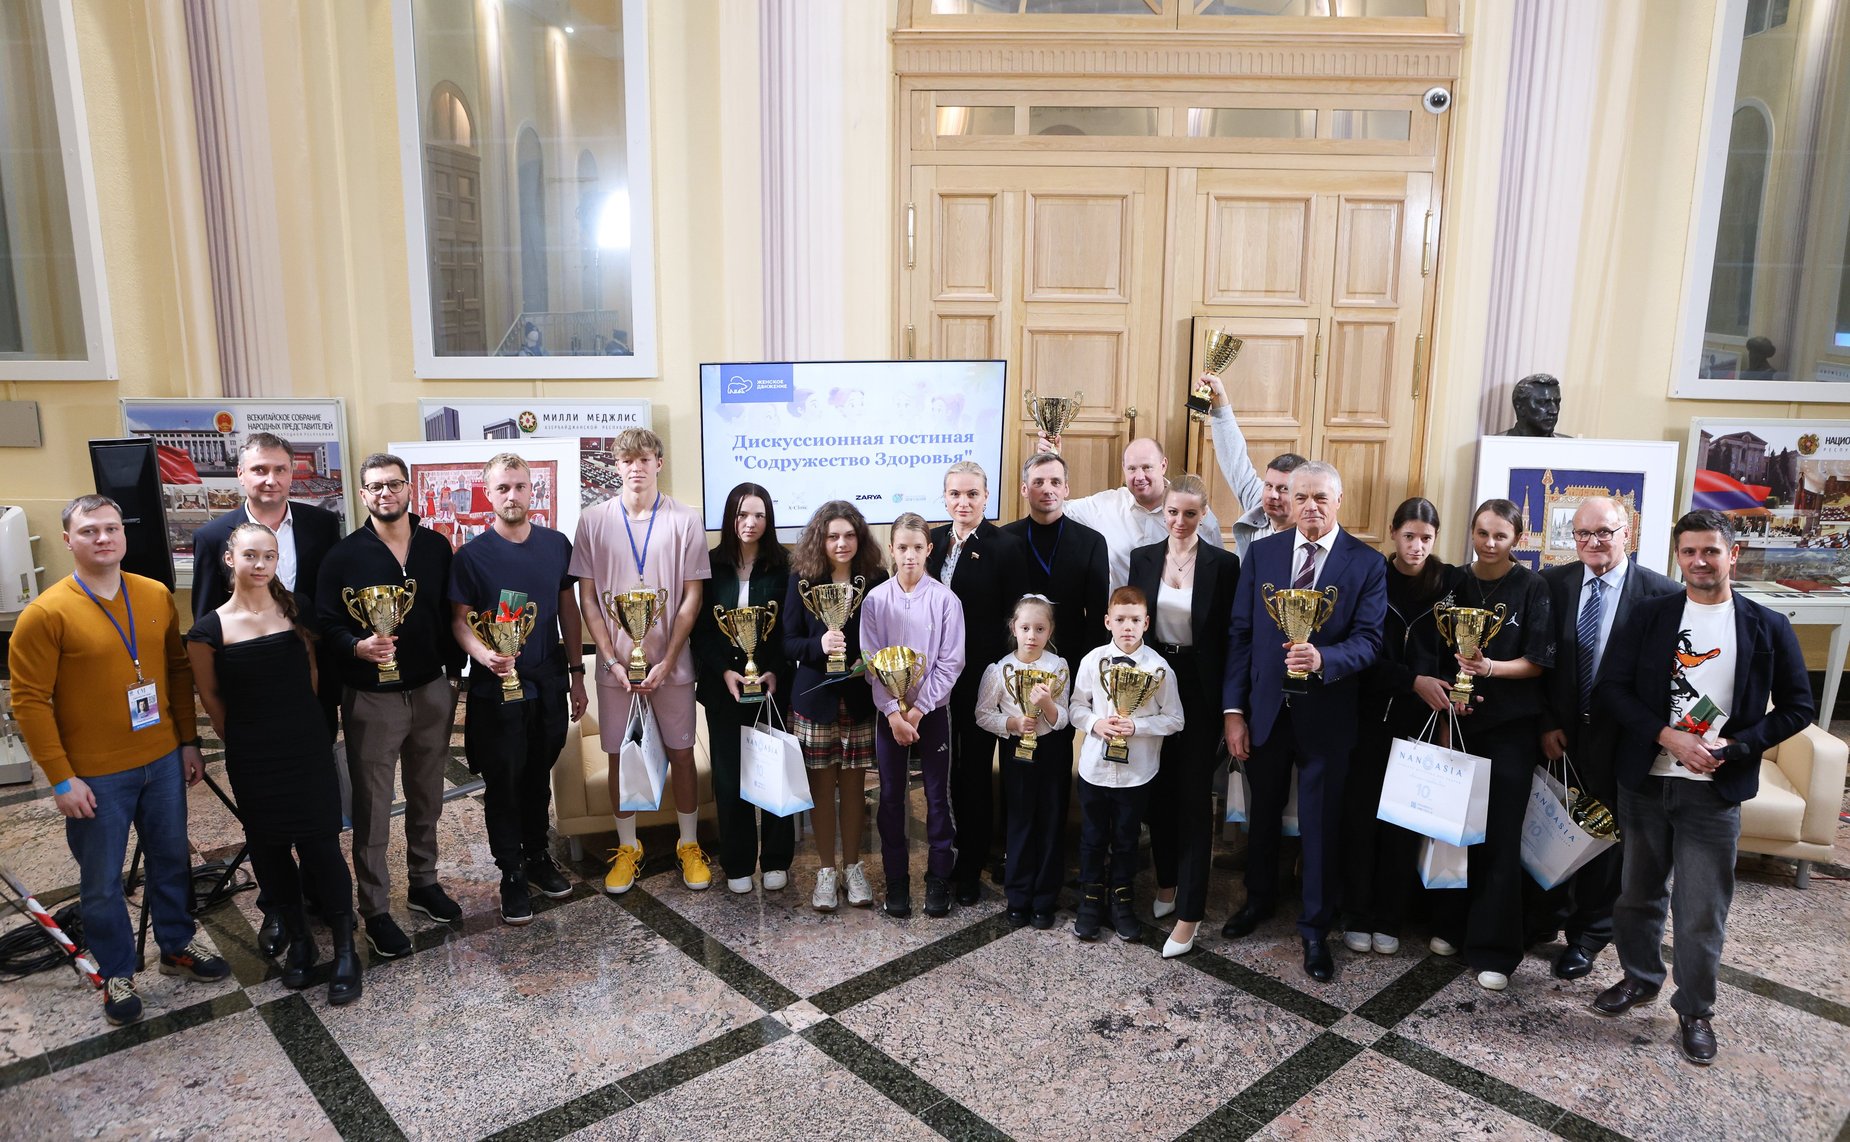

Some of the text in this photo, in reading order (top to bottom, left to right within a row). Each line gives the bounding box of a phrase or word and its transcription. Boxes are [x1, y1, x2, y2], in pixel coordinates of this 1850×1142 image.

[247, 412, 322, 421] ВСЕКИТАЙСКОЕ СОБРАНИЕ
[543, 413, 637, 423] МИЛЛИ МЕДЖЛИС
[248, 421, 334, 431] НАРОДНЫХ ПРЕДСТАВИТЕЛЕЙ
[732, 433, 974, 451] Дискуссионная гостиная
[734, 449, 972, 472] "Содружество Здоровья"
[1415, 783, 1431, 799] 10
